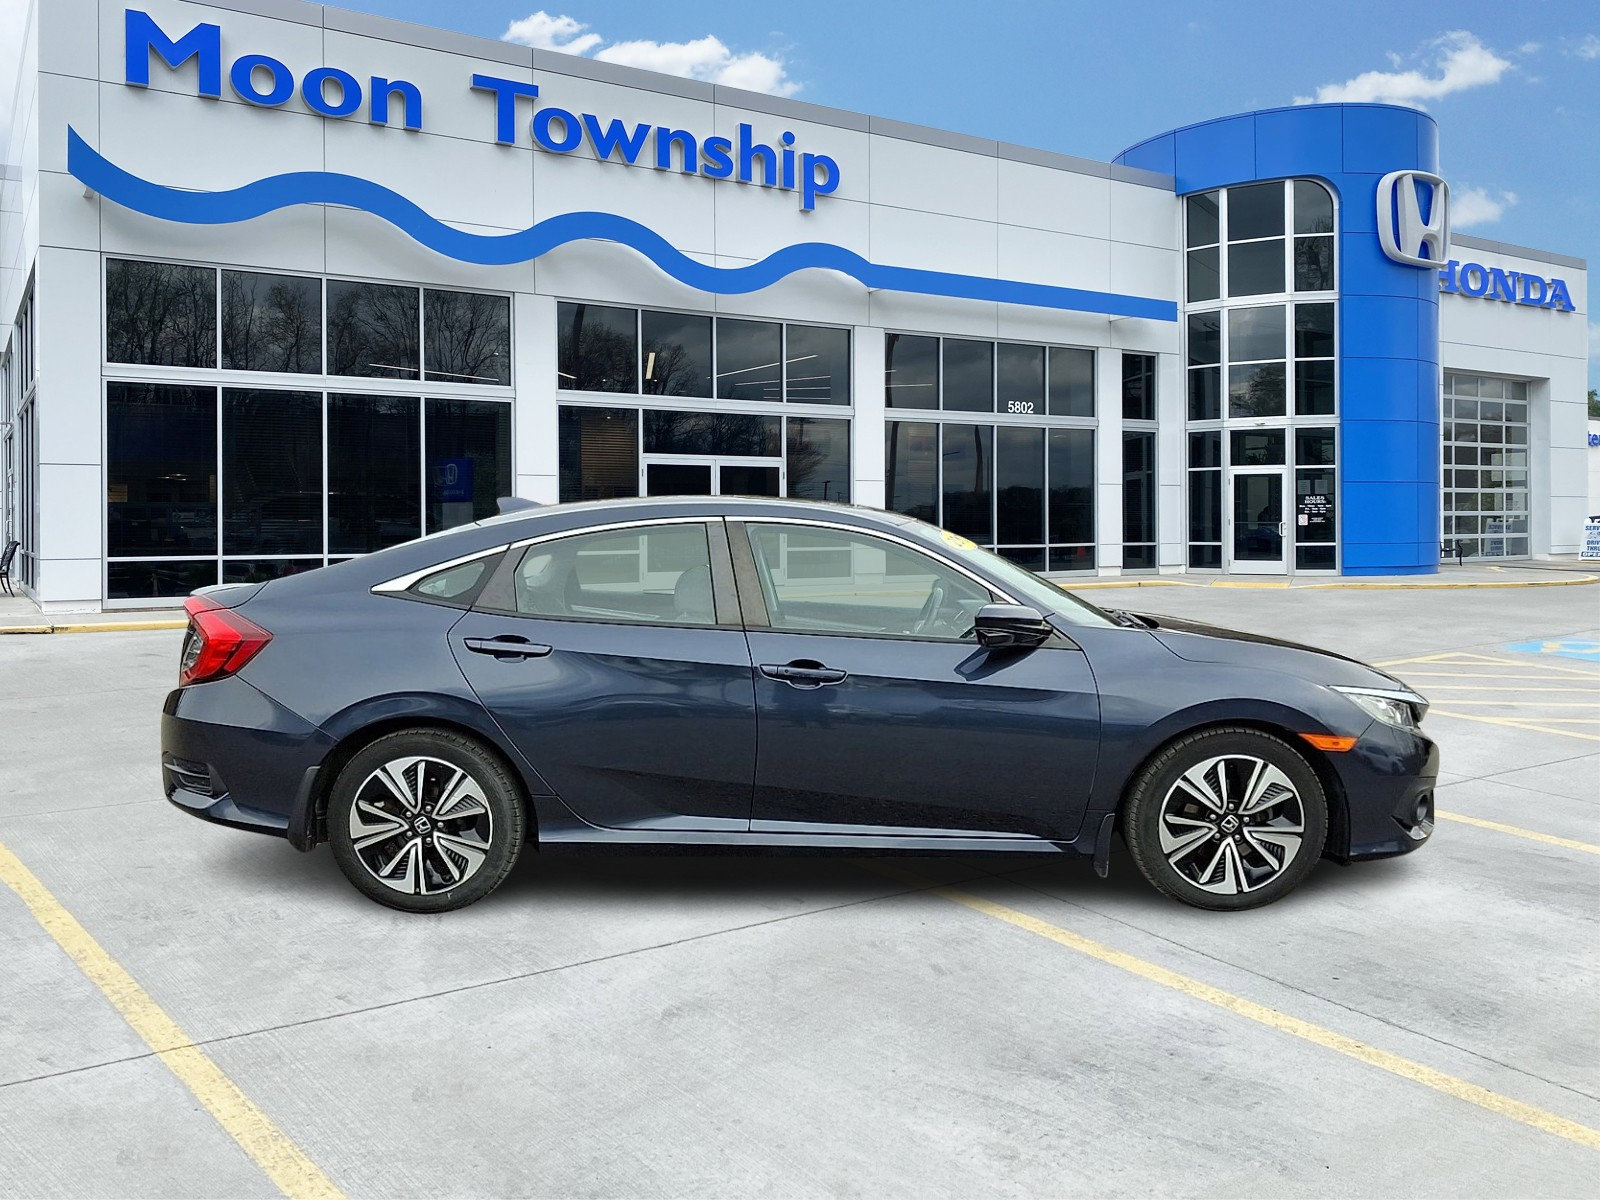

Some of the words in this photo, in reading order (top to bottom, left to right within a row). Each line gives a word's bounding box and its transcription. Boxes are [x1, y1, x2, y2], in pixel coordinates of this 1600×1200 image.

[124, 9, 422, 132] Moon
[469, 73, 841, 212] Township
[1007, 400, 1034, 414] 5802
